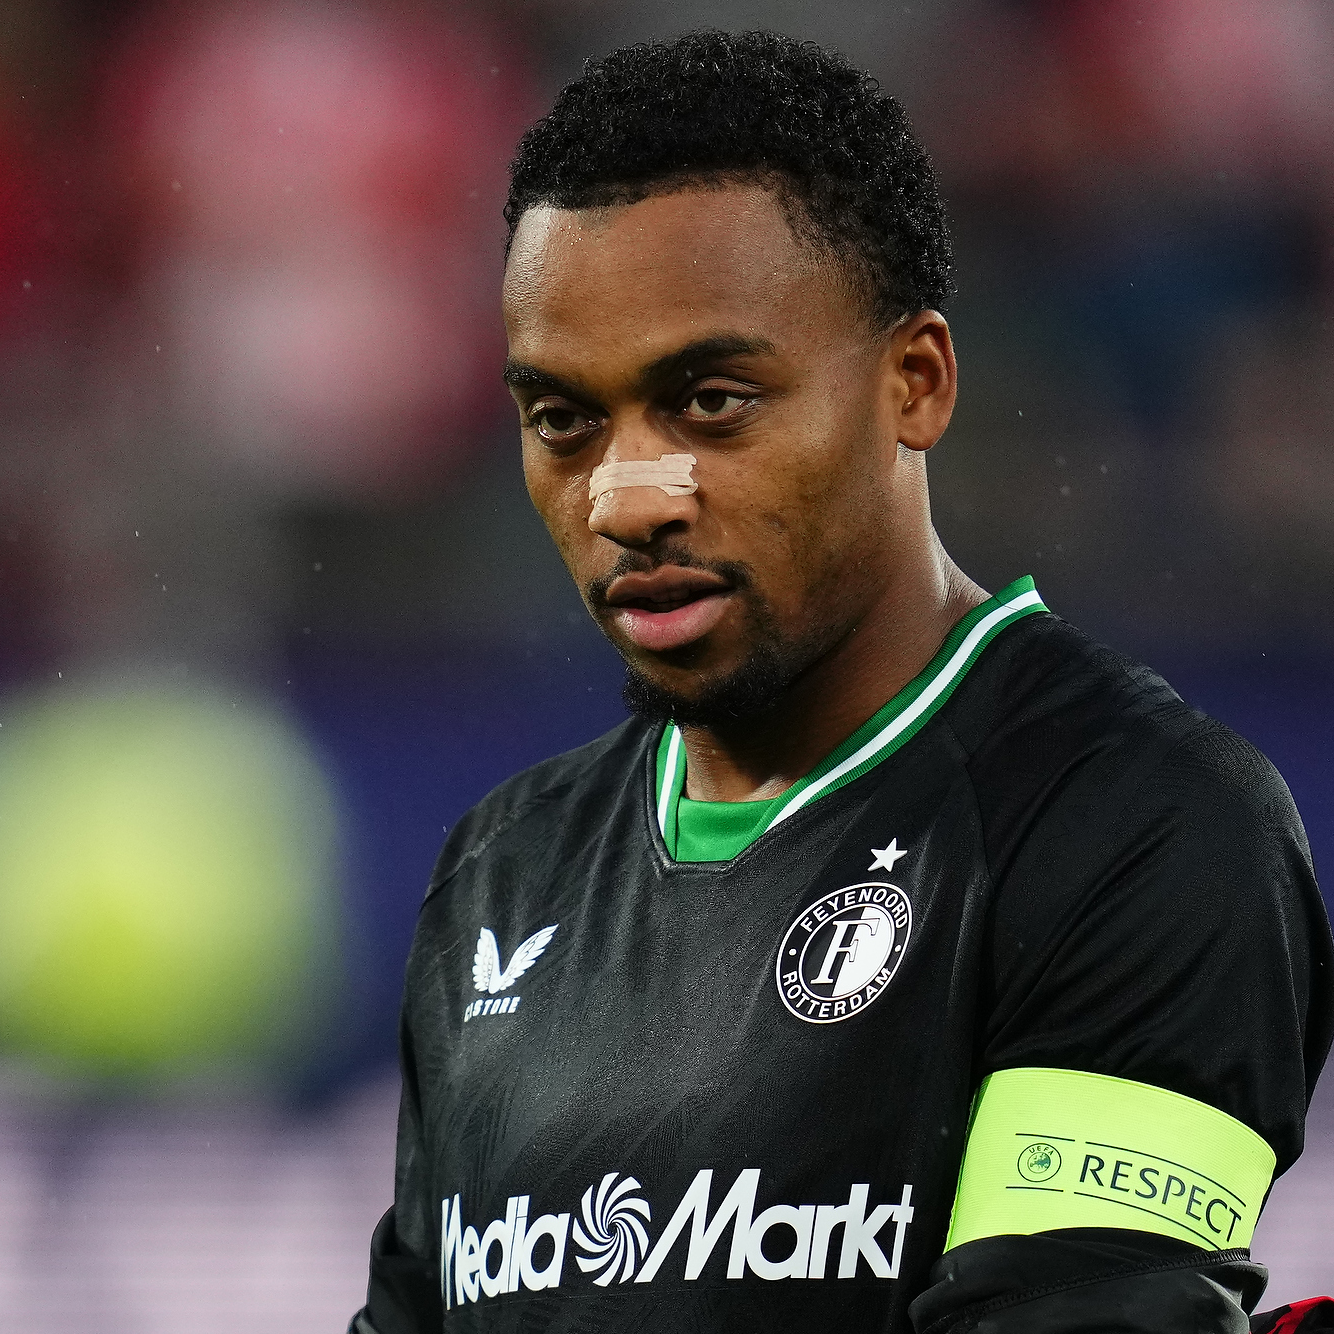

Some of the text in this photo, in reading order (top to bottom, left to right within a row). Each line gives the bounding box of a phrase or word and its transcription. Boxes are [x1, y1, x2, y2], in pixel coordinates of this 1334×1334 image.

[800, 888, 908, 933] FEYENOORD
[783, 967, 891, 1018] ROTTERDAM
[1028, 1145, 1055, 1156] UEFA
[1079, 1154, 1242, 1242] RESPECT
[441, 1168, 914, 1310] Media Markt
